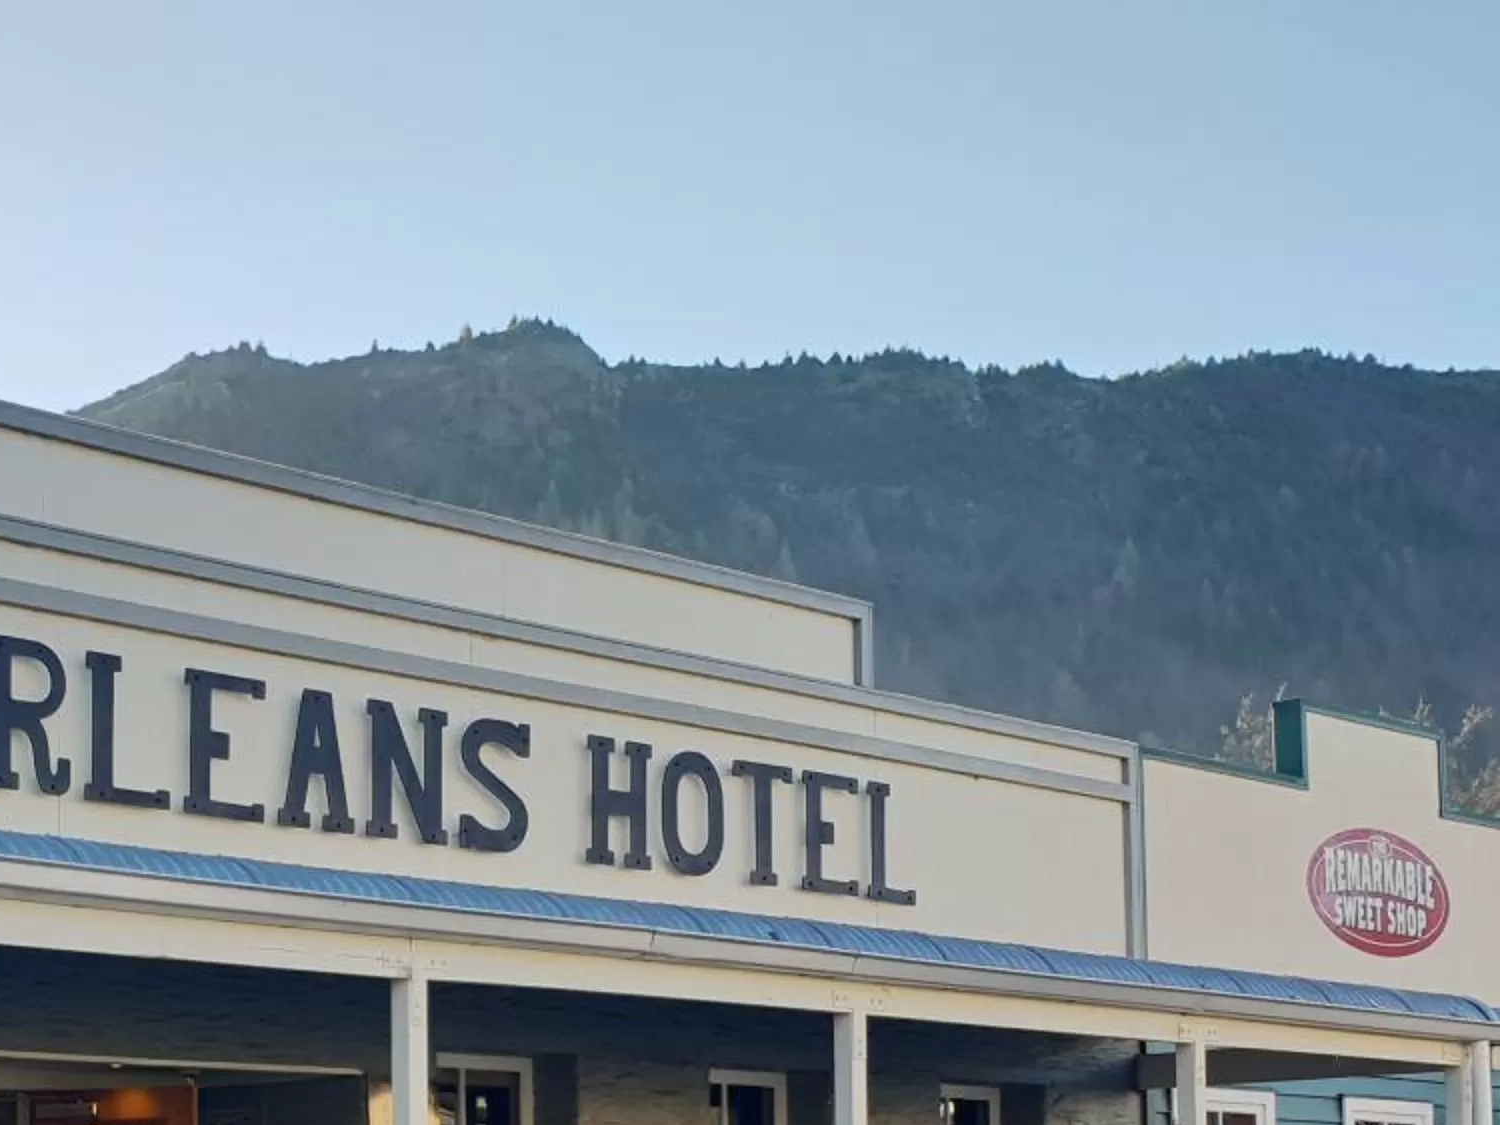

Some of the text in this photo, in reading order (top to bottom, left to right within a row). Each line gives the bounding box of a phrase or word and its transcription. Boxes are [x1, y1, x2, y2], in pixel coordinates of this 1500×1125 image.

[585, 733, 917, 906] HOTEL
[1324, 847, 1435, 909] REMARKABLE
[1334, 895, 1427, 939] SWEET SHOP
